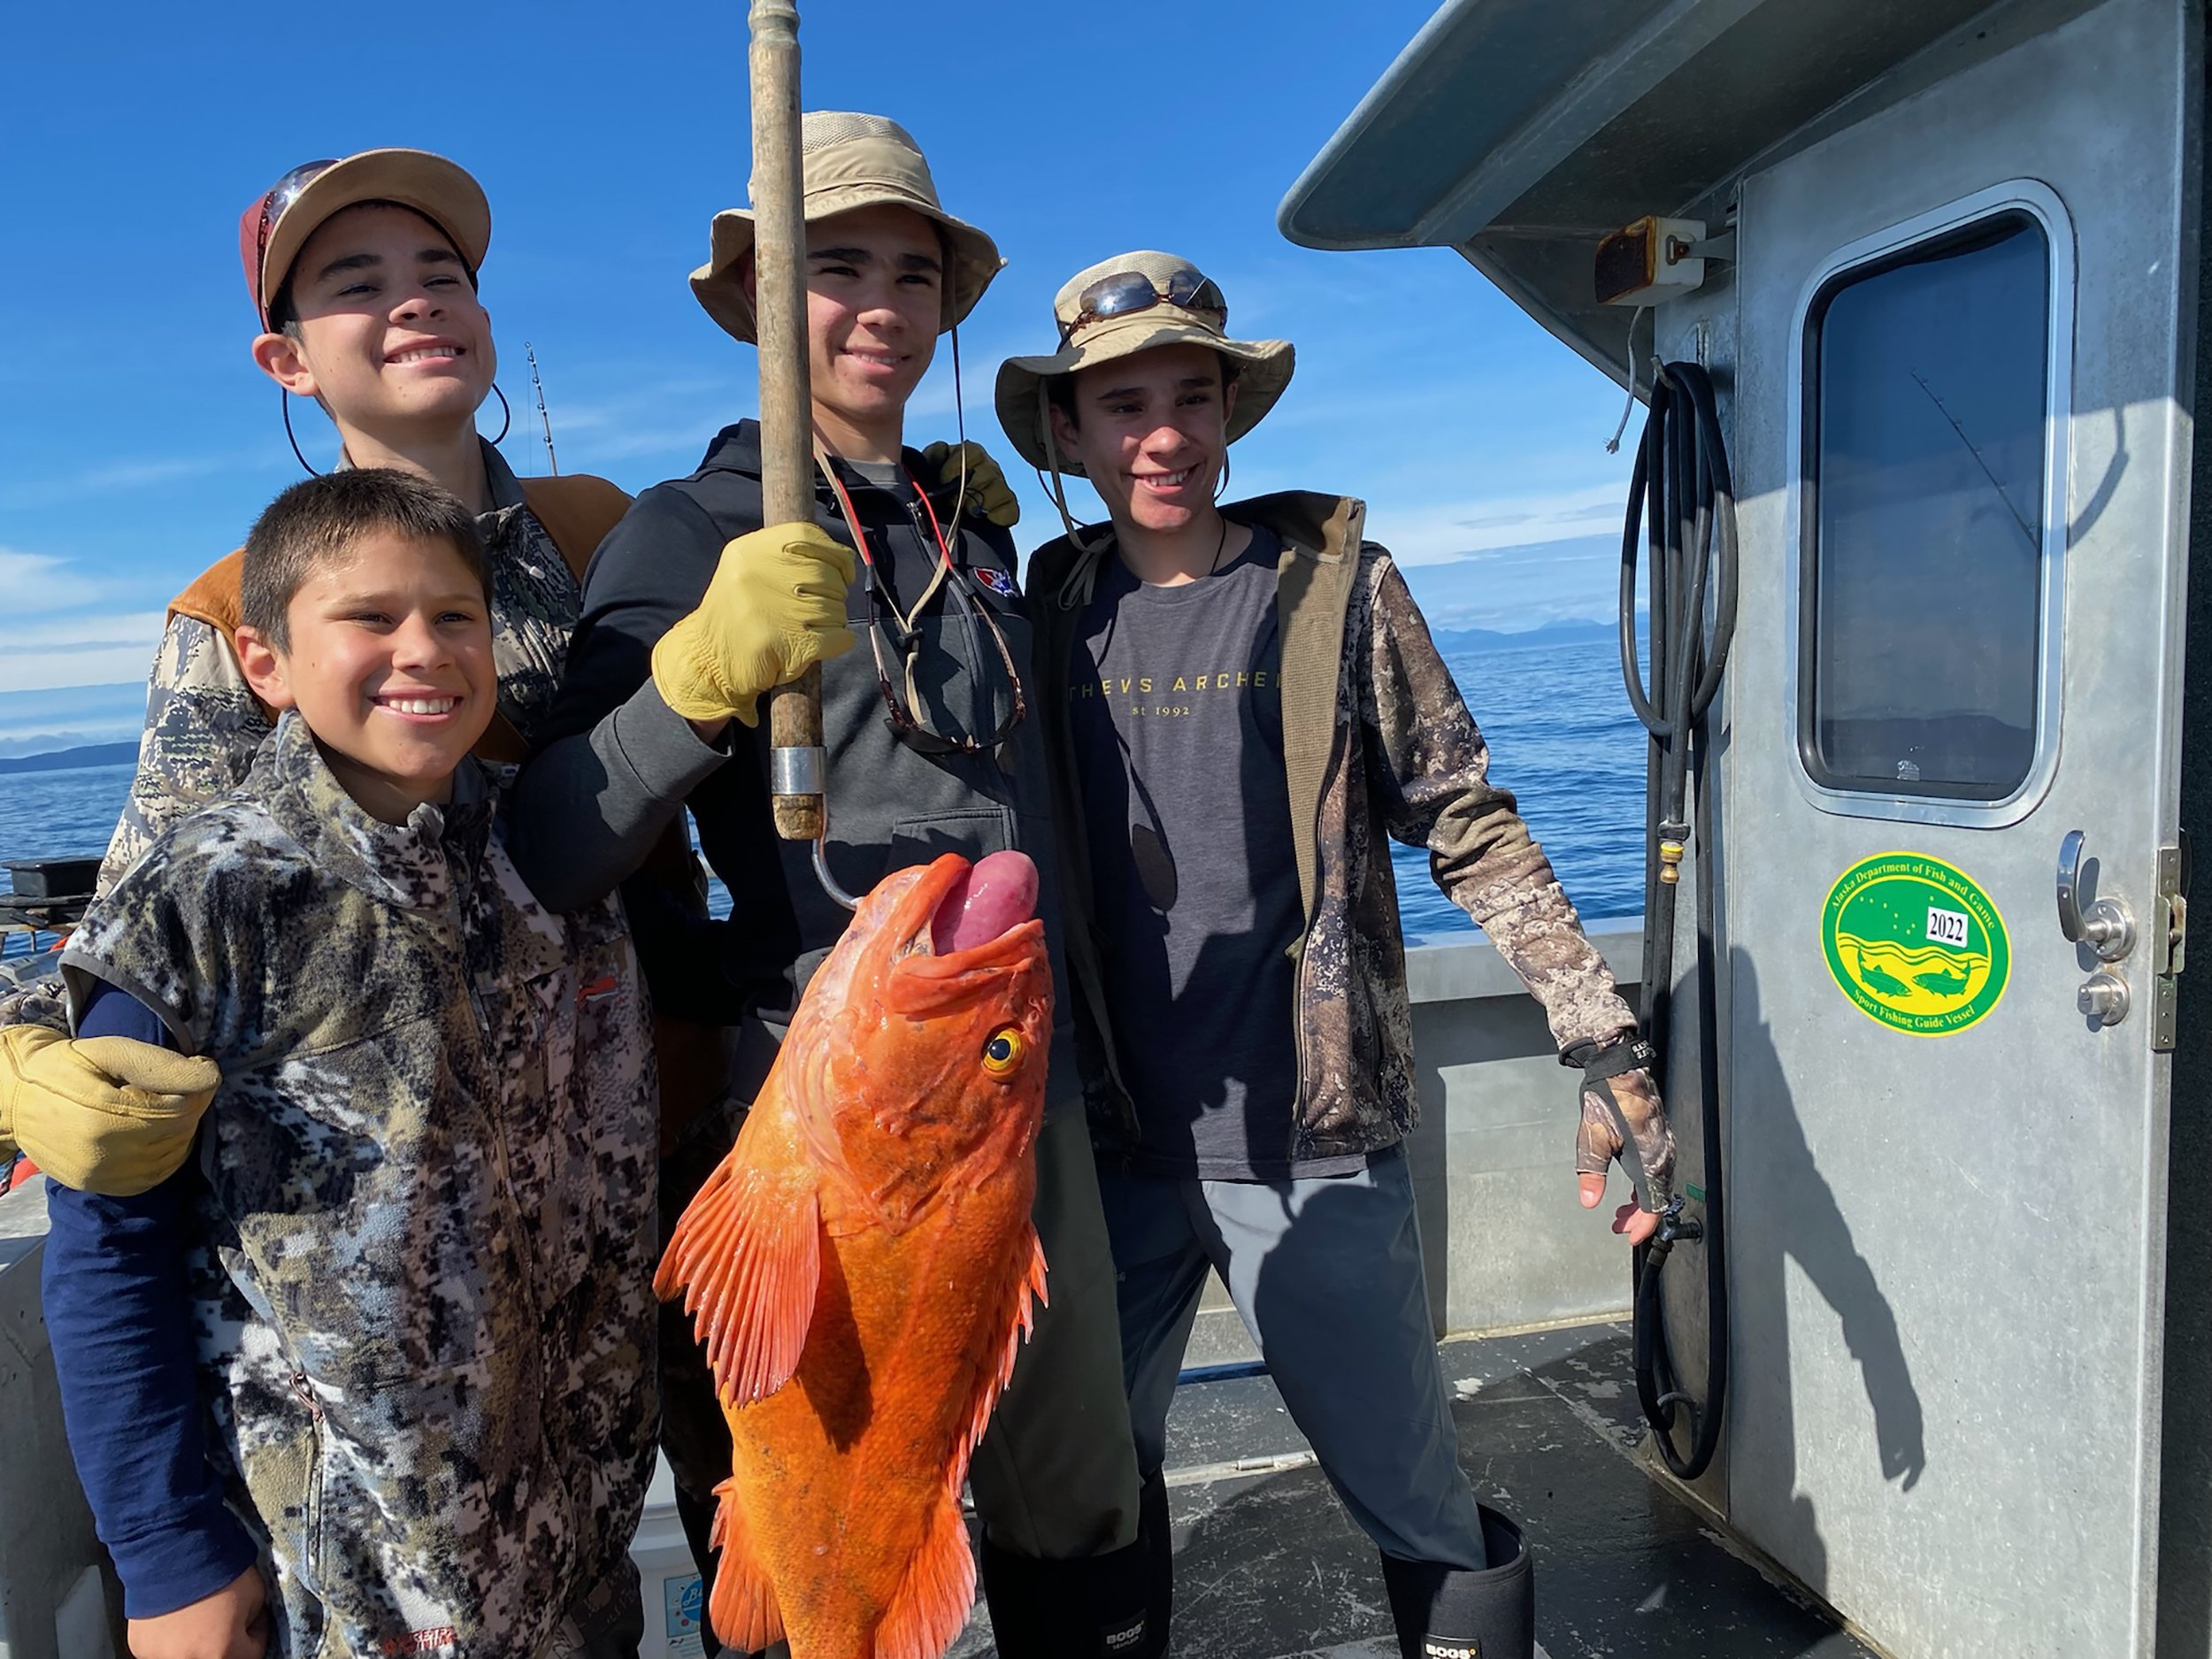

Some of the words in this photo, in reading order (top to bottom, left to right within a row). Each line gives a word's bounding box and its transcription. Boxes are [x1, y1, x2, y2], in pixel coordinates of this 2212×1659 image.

[1155, 706, 1190, 718] 1992
[1832, 879, 1856, 911] Alaska
[1855, 863, 1910, 883] Department
[1912, 864, 1924, 874] of
[1924, 864, 1947, 882] Fish
[1947, 878, 1969, 896] and
[1969, 892, 1995, 929] Game
[1930, 912, 1963, 942] 2022
[1854, 988, 1878, 1013] Sport
[1878, 1006, 1913, 1029] Fishing
[1915, 1016, 1945, 1029] Guide
[1945, 1003, 1976, 1025] Vessel
